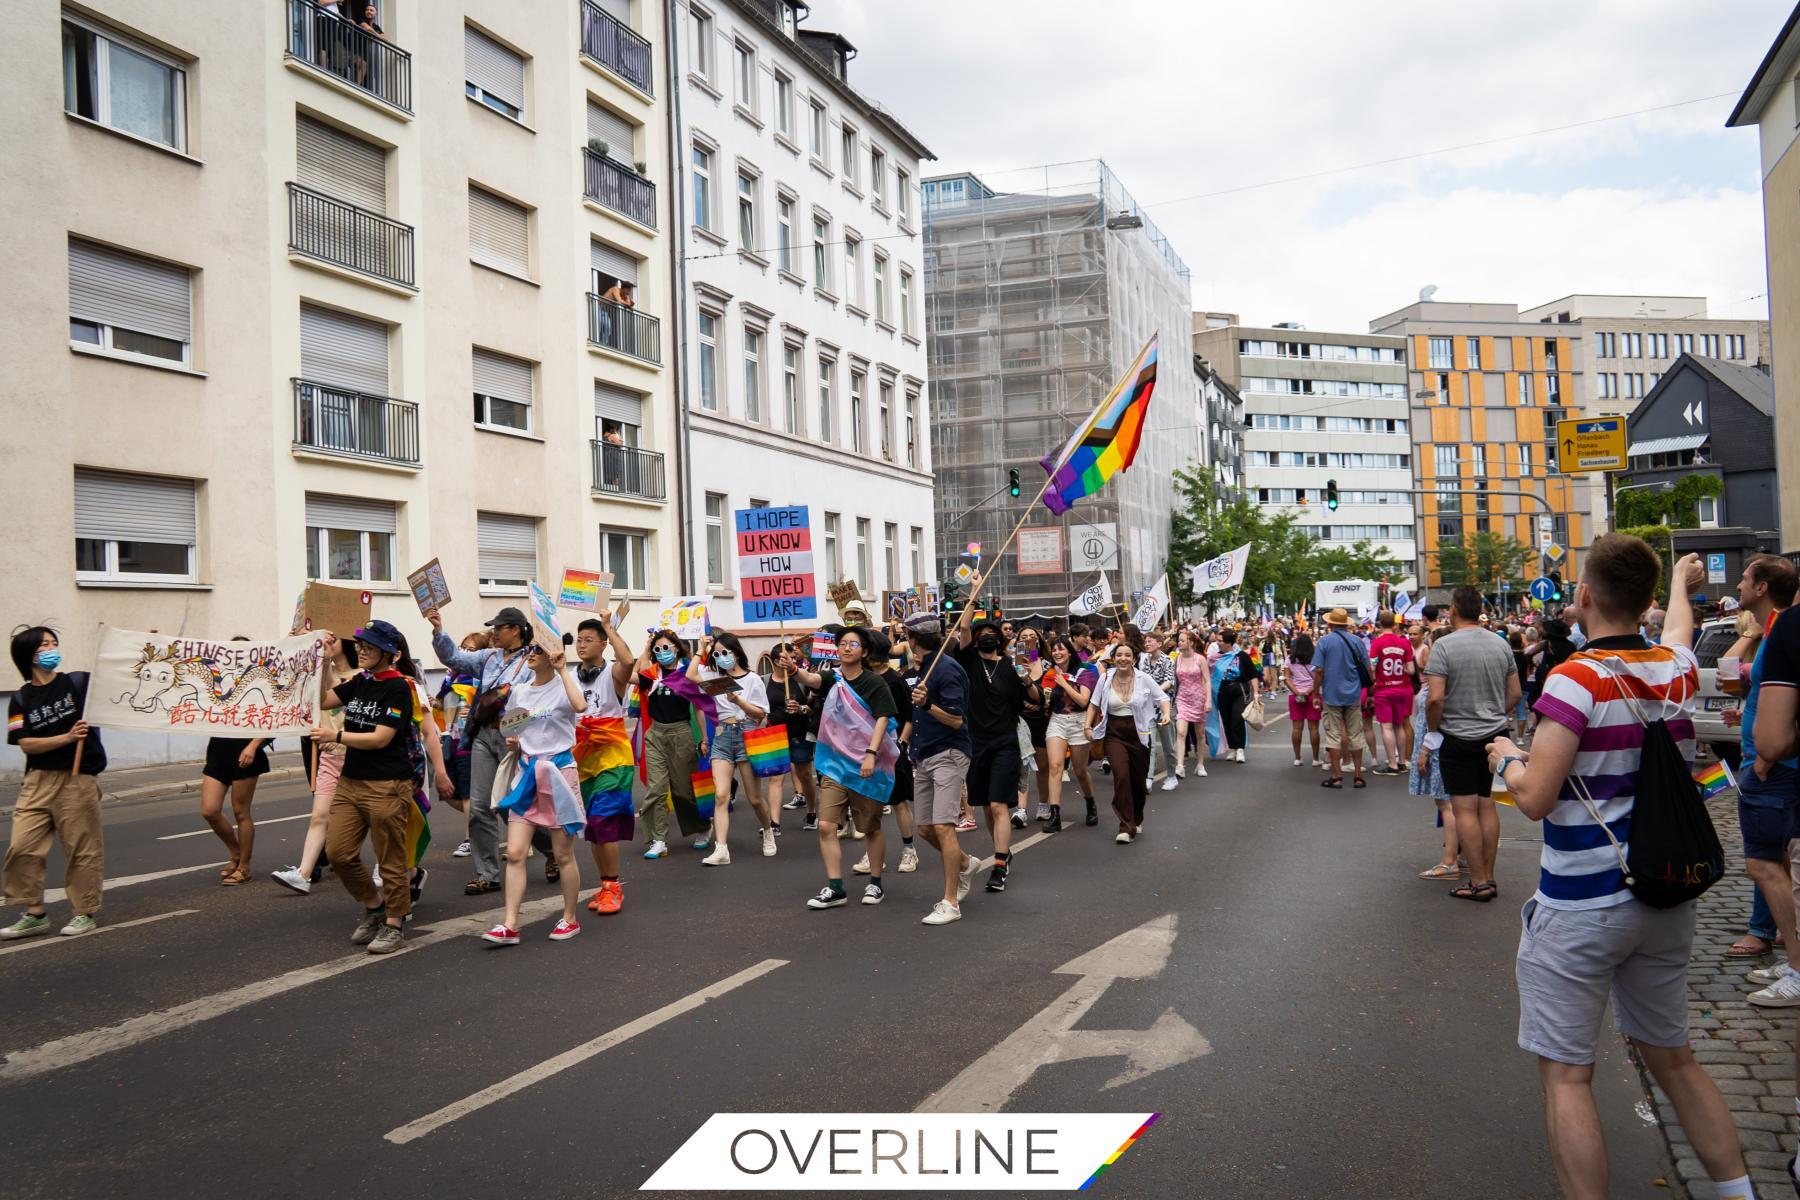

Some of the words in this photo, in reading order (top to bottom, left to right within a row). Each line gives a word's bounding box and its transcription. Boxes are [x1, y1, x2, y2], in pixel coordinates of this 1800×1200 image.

[744, 514, 751, 530] I
[757, 510, 800, 528] HOPE
[744, 535, 755, 552] U
[760, 533, 800, 551] KNOW
[760, 556, 791, 572] HOW
[1710, 556, 1720, 569] P
[750, 578, 804, 597] LOVED
[832, 584, 853, 597] MAKE
[756, 602, 766, 618] U
[772, 600, 803, 617] ARE
[172, 640, 245, 666] CHINESE
[250, 646, 286, 676] QUEER
[819, 648, 840, 658] TRA
[1382, 658, 1403, 676] 96
